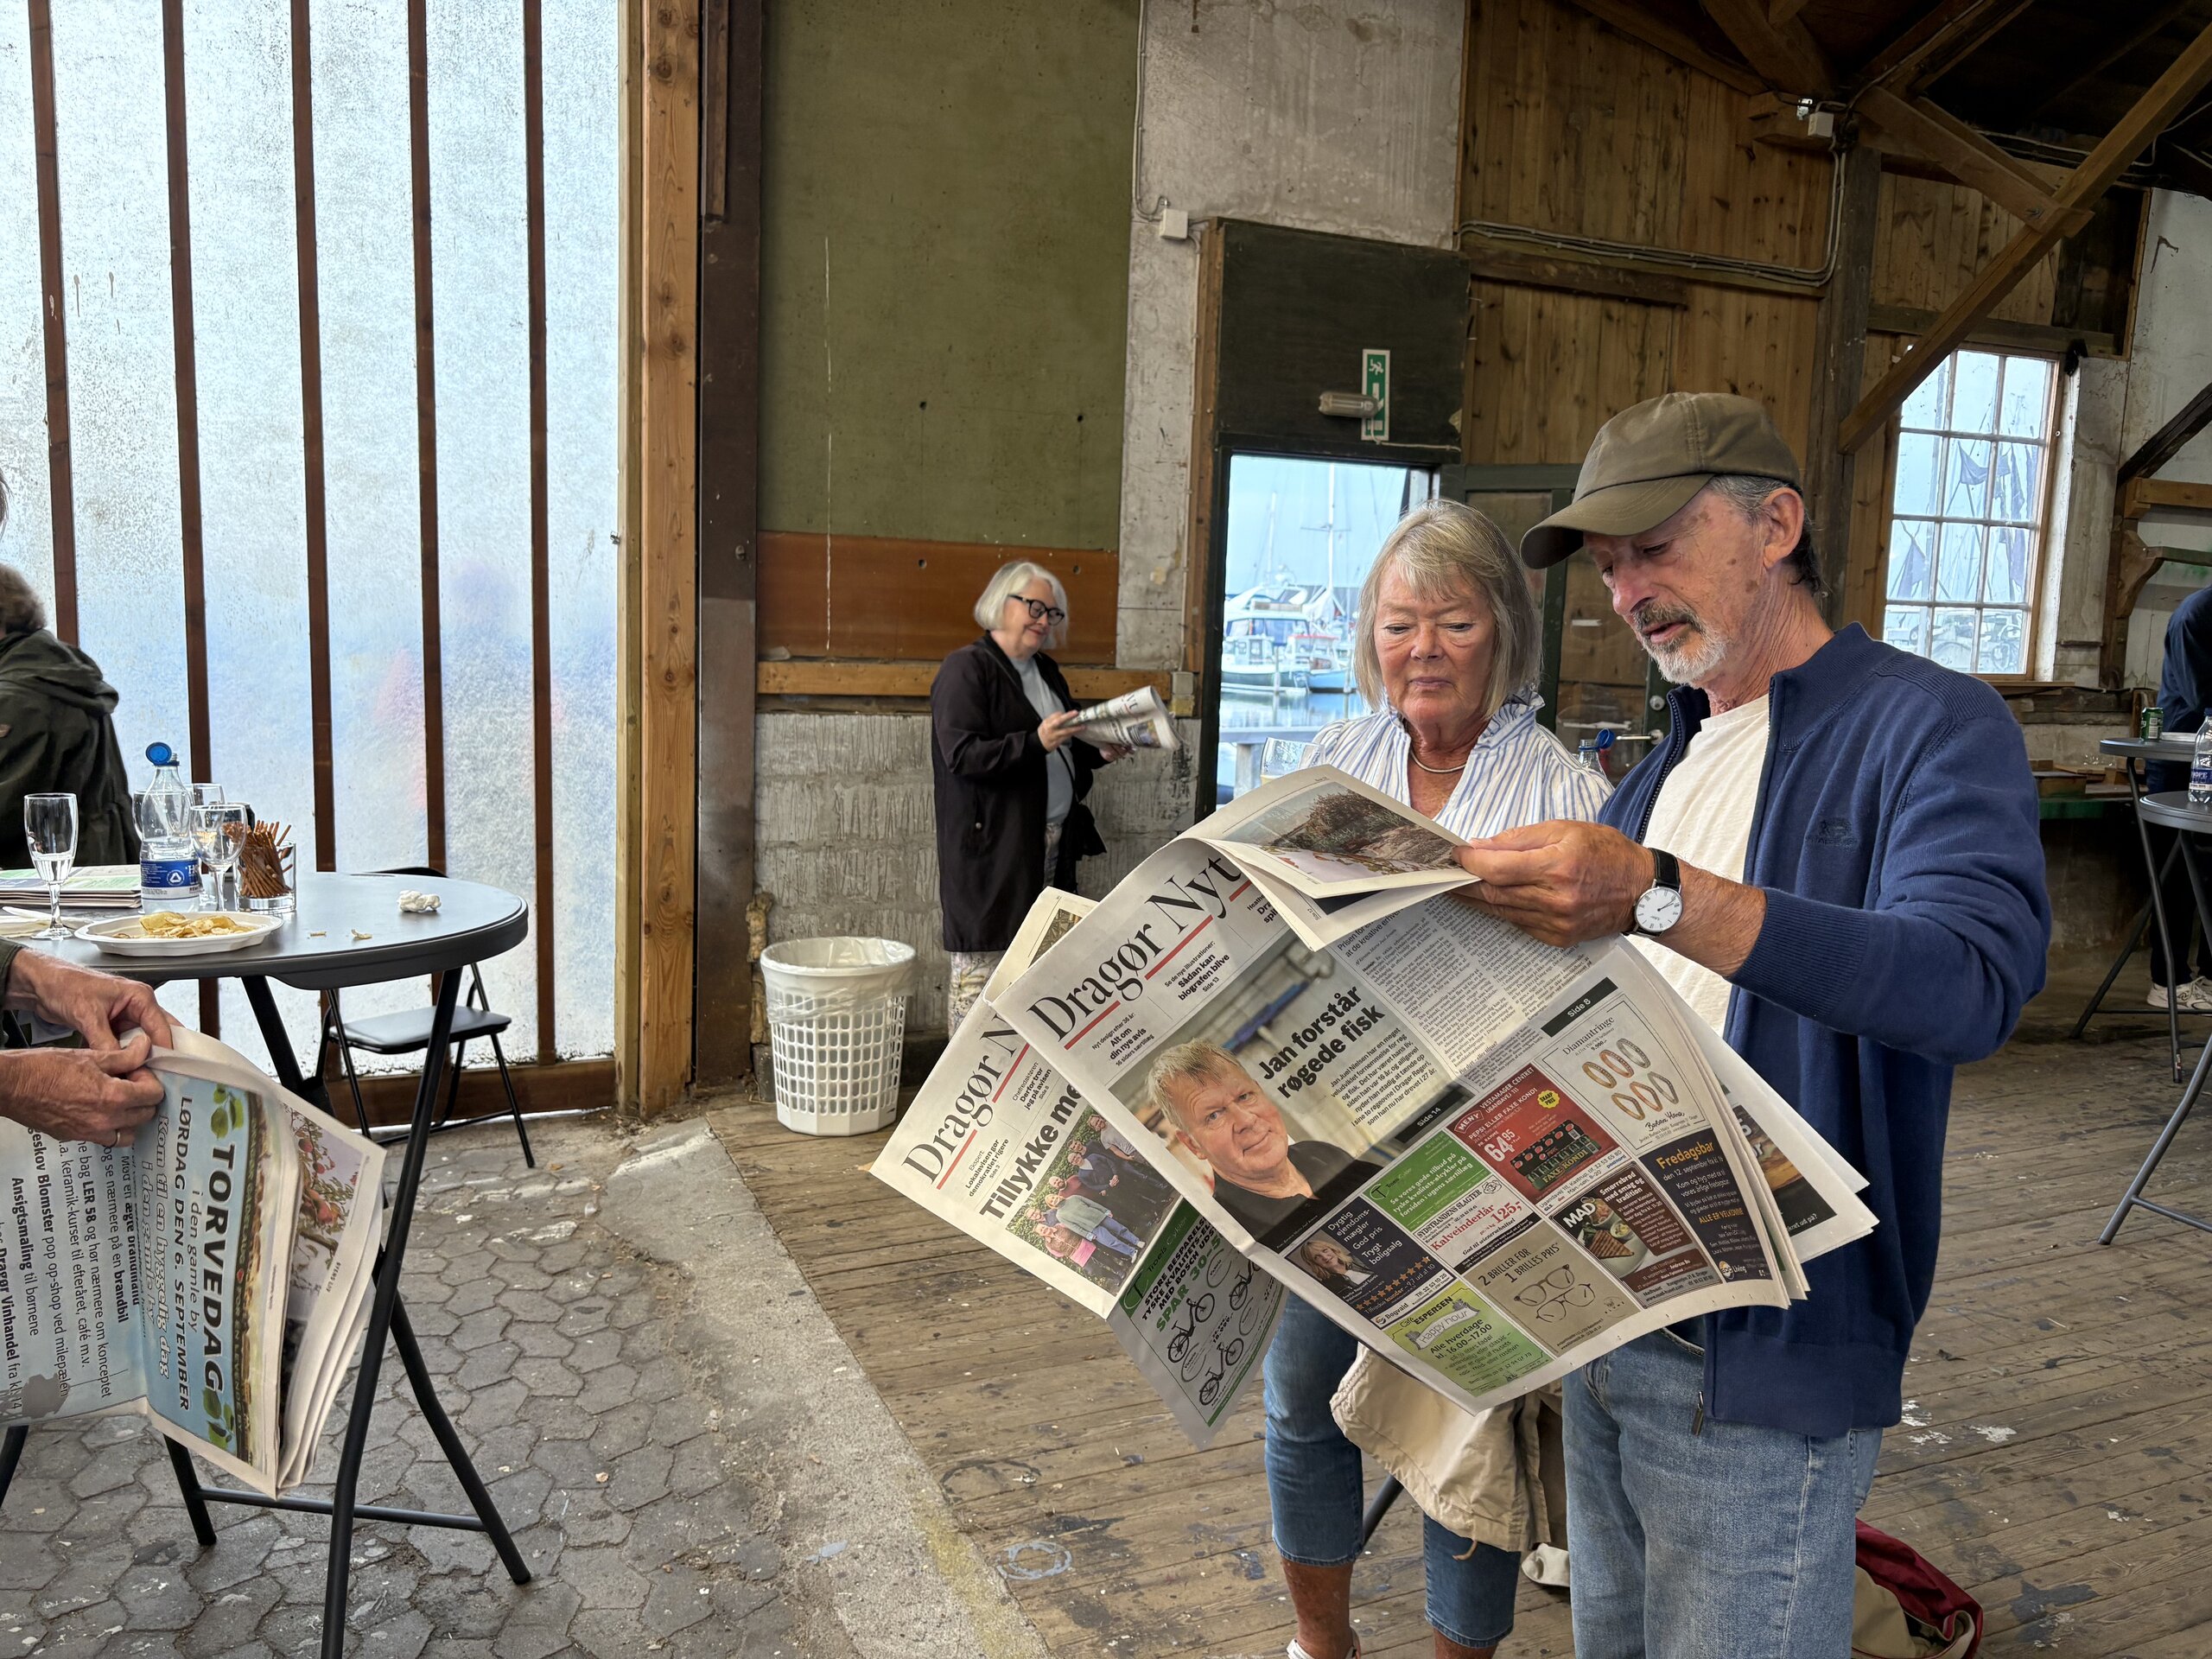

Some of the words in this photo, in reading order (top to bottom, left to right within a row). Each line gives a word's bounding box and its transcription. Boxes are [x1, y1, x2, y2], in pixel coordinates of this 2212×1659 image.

[1025, 922, 1165, 1043] Dragør
[1144, 858, 1242, 934] Nyt
[1177, 966, 1201, 988] Sådan
[1198, 953, 1217, 969] kan
[1177, 970, 1211, 1001] biografen
[1206, 953, 1230, 976] blive
[1566, 1002, 1586, 1018] Side
[1583, 997, 1592, 1006] 8
[1109, 1035, 1122, 1048] Alt
[1119, 1027, 1133, 1039] om
[1109, 1047, 1123, 1060] din
[1119, 1038, 1135, 1052] nye
[1130, 1027, 1147, 1041] avis
[1257, 1045, 1300, 1080] Jan
[1291, 986, 1362, 1050] forstår
[1561, 1017, 1614, 1055] Diamantringe
[1277, 1038, 1346, 1098] røgede
[1339, 1004, 1386, 1043] fisk
[1329, 1077, 1342, 1088] Jan
[1347, 1053, 1370, 1072] Nielsen
[1365, 1046, 1378, 1058] har
[1375, 1039, 1386, 1050] en
[1382, 1027, 1402, 1044] meget
[1356, 1047, 1390, 1077] fornemmelse
[1387, 1039, 1398, 1051] for
[1395, 1033, 1408, 1045] røg
[1020, 1080, 1035, 1103] Derfor
[1032, 1066, 1044, 1081] tror
[1035, 1068, 1052, 1091] avisen
[1340, 1091, 1351, 1102] og
[1357, 1075, 1371, 1087] Det
[1367, 1067, 1379, 1079] har
[1376, 1055, 1395, 1071] været
[1389, 1045, 1407, 1059] hans
[1353, 1097, 1370, 1114] nyder
[1367, 1090, 1382, 1103] han
[1377, 1077, 1397, 1094] stadig
[1393, 1071, 1402, 1081] at
[1398, 1058, 1419, 1076] tænde
[901, 1054, 1003, 1184] Dragør
[1415, 1113, 1433, 1128] Side
[1430, 1106, 1442, 1116] 14
[1457, 1112, 1479, 1131] MENY
[1467, 1125, 1486, 1141] PEPSI
[1484, 1112, 1505, 1128] ELLER
[1502, 1101, 1519, 1117] FAXE
[1517, 1086, 1539, 1104] KONDI
[154, 1113, 169, 1168] Kom
[175, 1096, 193, 1190] LØRDAG
[1484, 1132, 1516, 1161] 64
[1656, 1141, 1713, 1169] Fredagsbar
[76, 1154, 92, 1179] bag
[104, 1163, 115, 1179] se
[978, 1124, 1058, 1219] Tillykke
[1662, 1172, 1675, 1182] den
[81, 1179, 96, 1205] LER
[155, 1172, 168, 1199] til
[1455, 1189, 1483, 1210] SLAGTER
[1603, 1189, 1619, 1203] med
[1617, 1180, 1637, 1195] smag
[1633, 1176, 1645, 1185] og
[1615, 1186, 1643, 1205] tradition
[36, 1173, 55, 1233] Blomster
[60, 1158, 80, 1247] keramik-kurser
[84, 1205, 98, 1224] 58
[105, 1179, 119, 1234] nærmere
[155, 1201, 166, 1232] en
[1562, 1200, 1596, 1228] MAD
[1698, 1213, 1713, 1224] ALLE
[11, 1178, 34, 1270] Ansigtsmaling
[84, 1224, 97, 1242] og
[173, 1197, 185, 1247] DEN
[188, 1201, 203, 1239] den
[1326, 1211, 1354, 1231] Dygtig
[1335, 1208, 1370, 1236] ejendoms-
[1343, 1220, 1370, 1243] mægler
[1430, 1205, 1494, 1251] Kalveinderlår
[41, 1235, 57, 1260] pop
[87, 1241, 101, 1263] hør
[108, 1235, 123, 1250] på
[1351, 1235, 1370, 1250] God
[1368, 1225, 1383, 1240] pris
[1360, 1242, 1382, 1258] Trygt
[1368, 1240, 1402, 1265] boligsalg
[70, 1248, 84, 1262] til
[111, 1252, 122, 1269] en
[174, 1251, 185, 1270] 6.
[202, 1144, 235, 1392] TORVEDAG
[1477, 1274, 1491, 1287] 2
[1486, 1256, 1518, 1280] BRILLER
[1513, 1247, 1532, 1262] FOR
[1503, 1271, 1518, 1284] 1
[1513, 1254, 1544, 1276] BRILLES
[22, 1271, 37, 1285] til
[45, 1262, 62, 1310] op-shop
[72, 1262, 88, 1316] efteråret,
[151, 1236, 168, 1333] hyggelig
[186, 1243, 200, 1303] gamle
[1144, 1272, 1167, 1306] STORE
[1158, 1285, 1175, 1311] MED
[1174, 1250, 1199, 1285] BOSCH
[89, 1265, 104, 1319] nærmere
[114, 1269, 129, 1323] brandbil
[1141, 1287, 1165, 1320] TYSKE
[1156, 1283, 1190, 1332] SPAR
[24, 1286, 40, 1337] børnene
[52, 1312, 66, 1335] ved
[187, 1310, 200, 1333] by
[1413, 1295, 1453, 1325] ESPERSEN
[1417, 1321, 1447, 1344] Happy
[1443, 1306, 1467, 1325] hour
[77, 1317, 91, 1342] café
[94, 1320, 106, 1341] om
[174, 1278, 190, 1411] SEPTEMBER
[1429, 1342, 1446, 1355] Alle
[1445, 1319, 1484, 1344] hverdage
[54, 1337, 72, 1398] milepælen
[79, 1343, 91, 1369] m.v.
[97, 1342, 113, 1398] konceptet
[157, 1334, 170, 1379] dag
